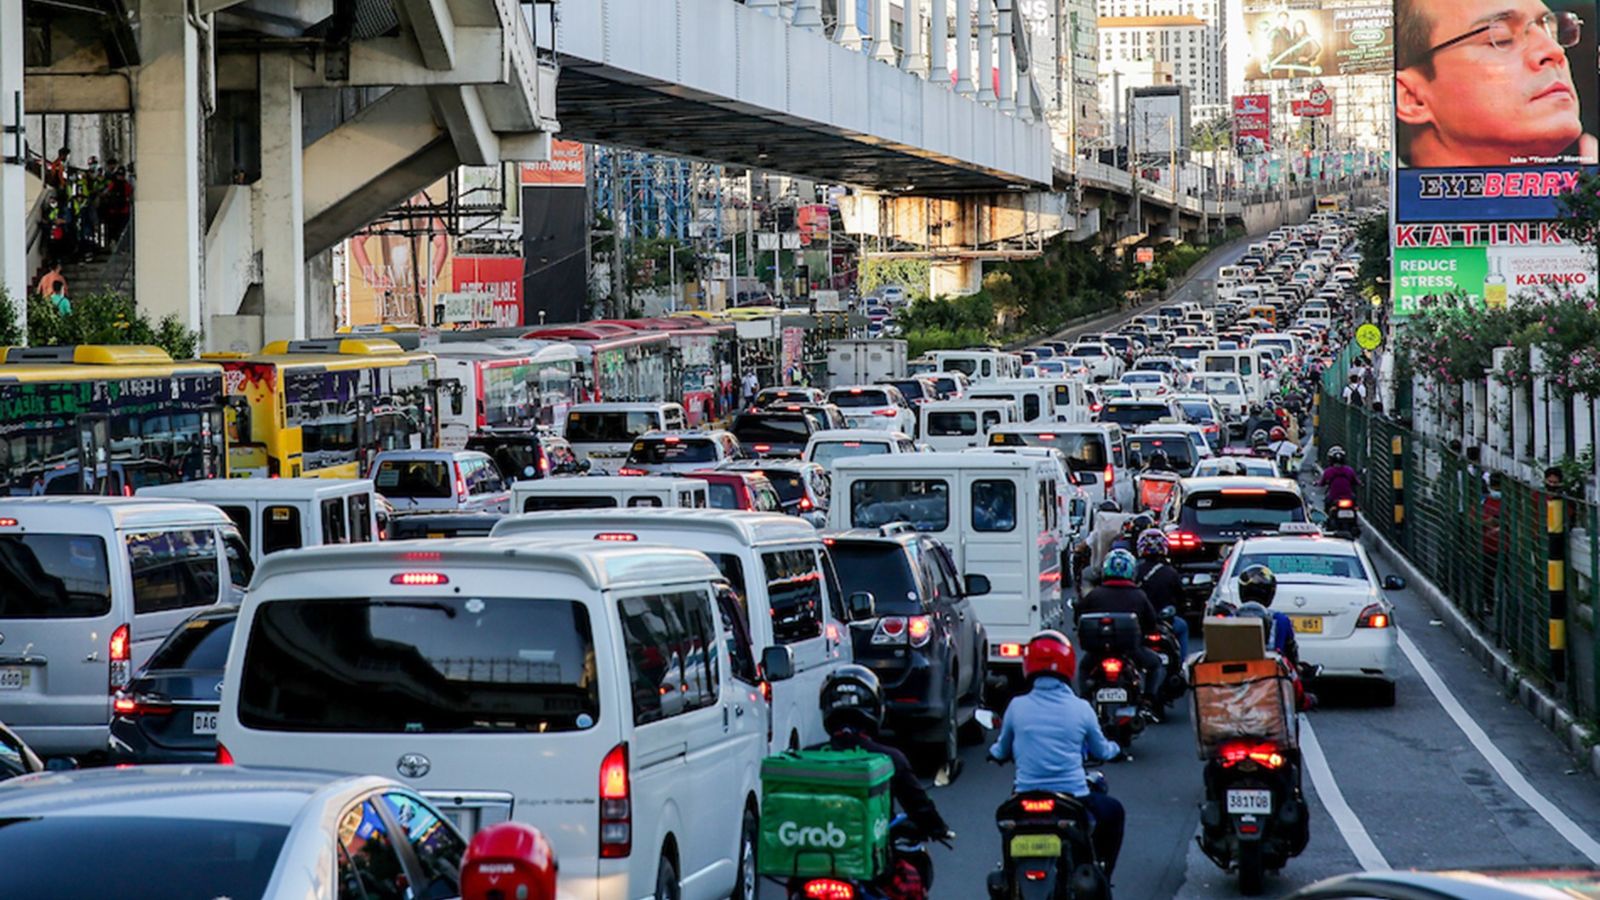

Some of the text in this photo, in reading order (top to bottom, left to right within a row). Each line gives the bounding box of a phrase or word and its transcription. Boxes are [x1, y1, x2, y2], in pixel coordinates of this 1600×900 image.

[1420, 171, 1580, 198] EYEBERRY
[1400, 259, 1457, 271] REDUCE
[1400, 275, 1457, 289] STRESS,
[1516, 272, 1586, 285] KATINKO
[778, 821, 847, 848] Grab
